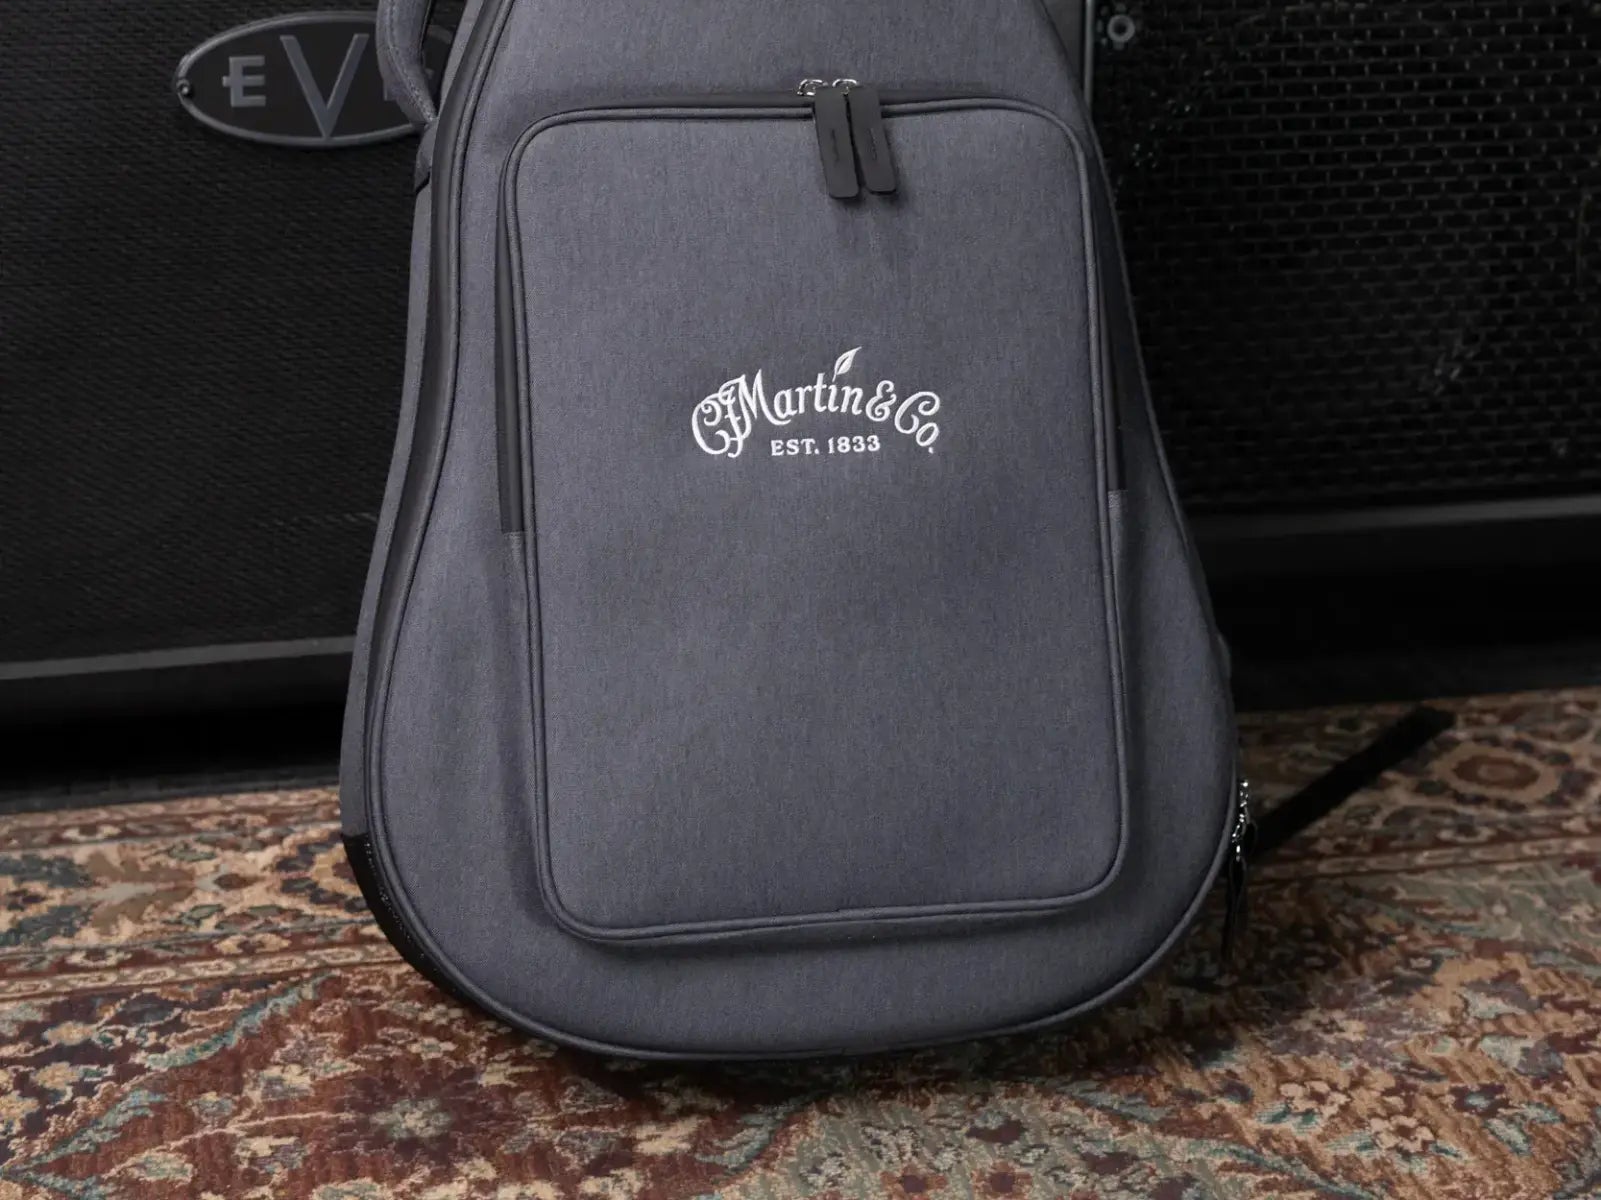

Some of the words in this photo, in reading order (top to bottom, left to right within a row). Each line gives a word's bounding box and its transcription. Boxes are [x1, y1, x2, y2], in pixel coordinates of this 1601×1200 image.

[222, 34, 412, 139] EV
[770, 438, 820, 456] EST.
[828, 434, 881, 454] 1833
